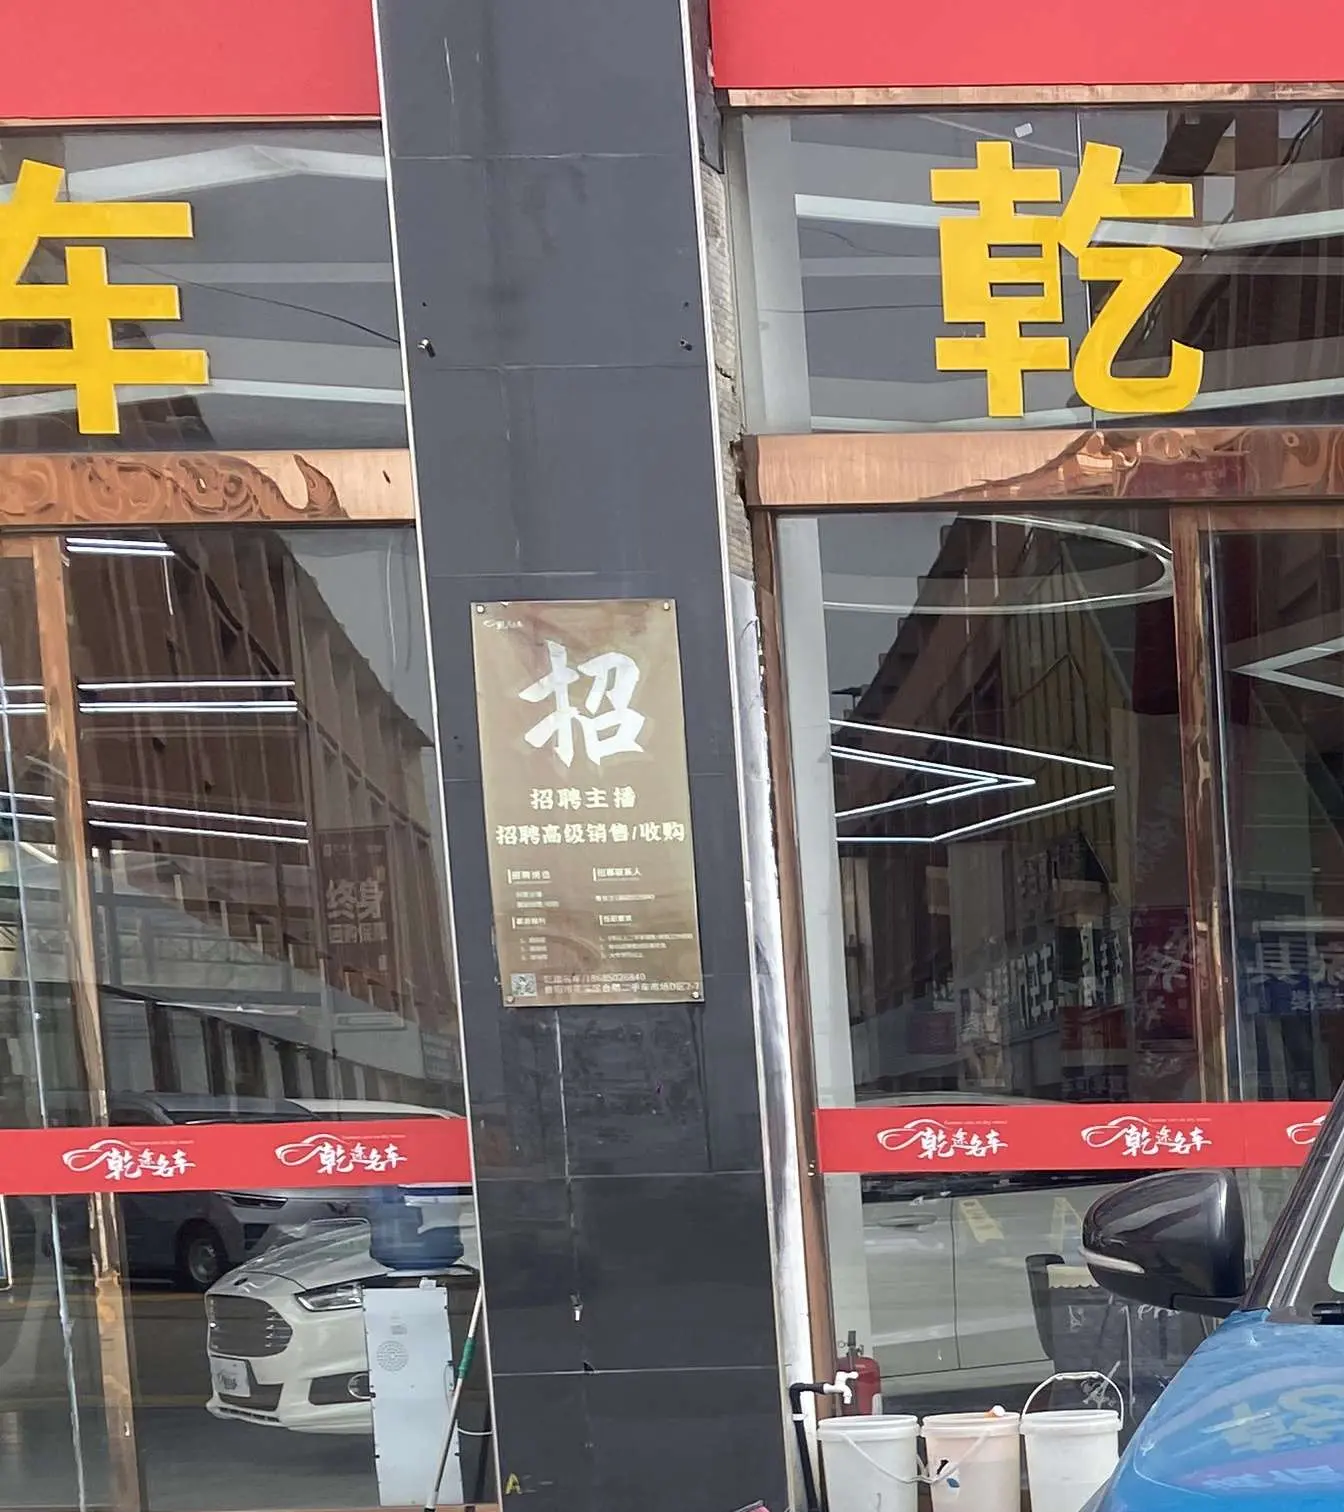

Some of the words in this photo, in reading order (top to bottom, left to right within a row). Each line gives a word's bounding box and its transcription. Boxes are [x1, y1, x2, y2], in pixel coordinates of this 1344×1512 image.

[519, 640, 645, 767] 招
[530, 786, 636, 811] 招聘主播
[496, 822, 685, 846] 招聘高级销售/收购
[917, 1126, 1008, 1160] 乾途名车
[1121, 1125, 1212, 1157] 乾途名车
[105, 1147, 196, 1180] 乾途名车
[317, 1142, 407, 1174] 乾途名车
